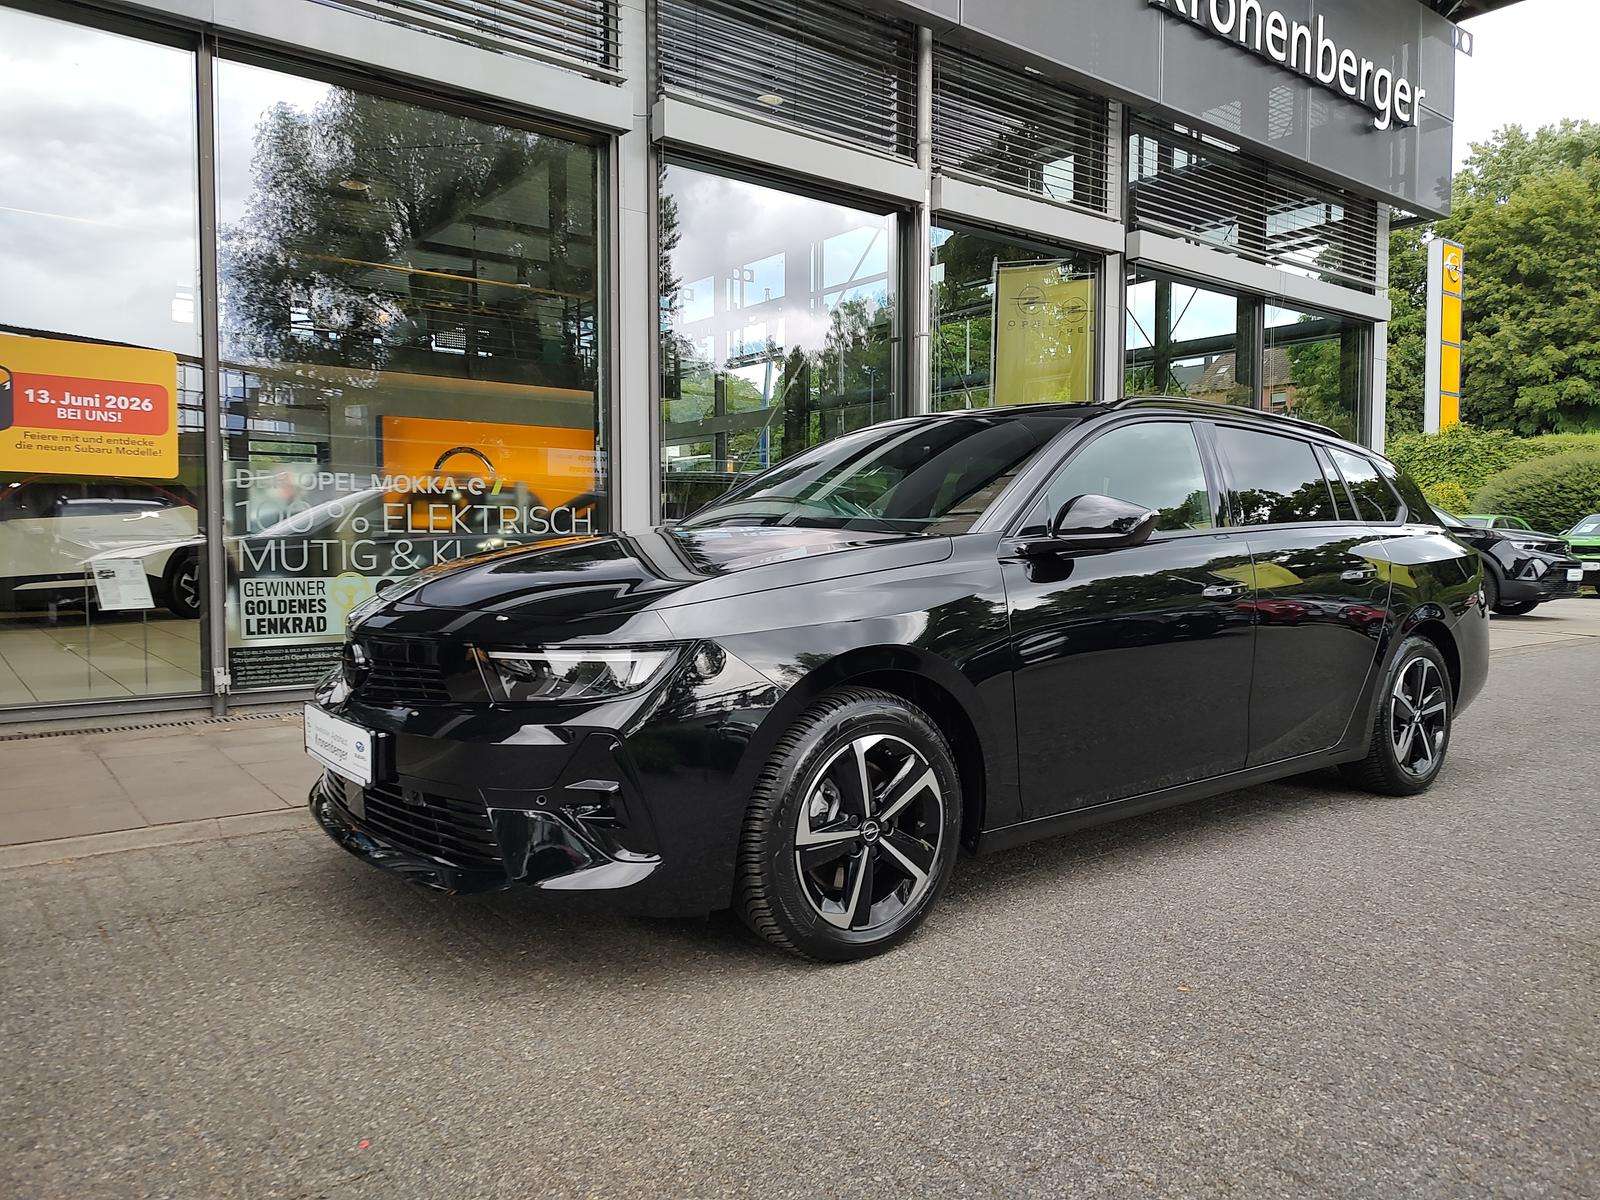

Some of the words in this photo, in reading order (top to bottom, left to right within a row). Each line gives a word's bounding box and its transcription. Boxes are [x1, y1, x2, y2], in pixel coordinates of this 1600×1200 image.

[1157, 0, 1426, 131] onenberger
[24, 389, 56, 404] 13.
[59, 391, 100, 407] Juni
[105, 395, 154, 411] 2026
[56, 409, 82, 420] BEI
[85, 410, 122, 422] UNS!
[15, 440, 33, 450] die
[35, 443, 71, 452] neuen
[74, 444, 112, 455] Subaru
[115, 446, 162, 457] Modelle!
[23, 431, 58, 441] Feiere
[61, 433, 80, 442] mit
[82, 434, 104, 444] und
[106, 437, 154, 447] entdecke
[300, 471, 363, 492] OPEL
[370, 473, 486, 496] MOKKA-e
[235, 500, 314, 533] 100
[327, 502, 369, 533] %
[239, 538, 377, 571] MUTIG
[391, 539, 421, 570] &
[244, 581, 326, 597] GEWINNER
[245, 598, 327, 615] GOLDENES
[246, 616, 327, 635] LENKRAD
